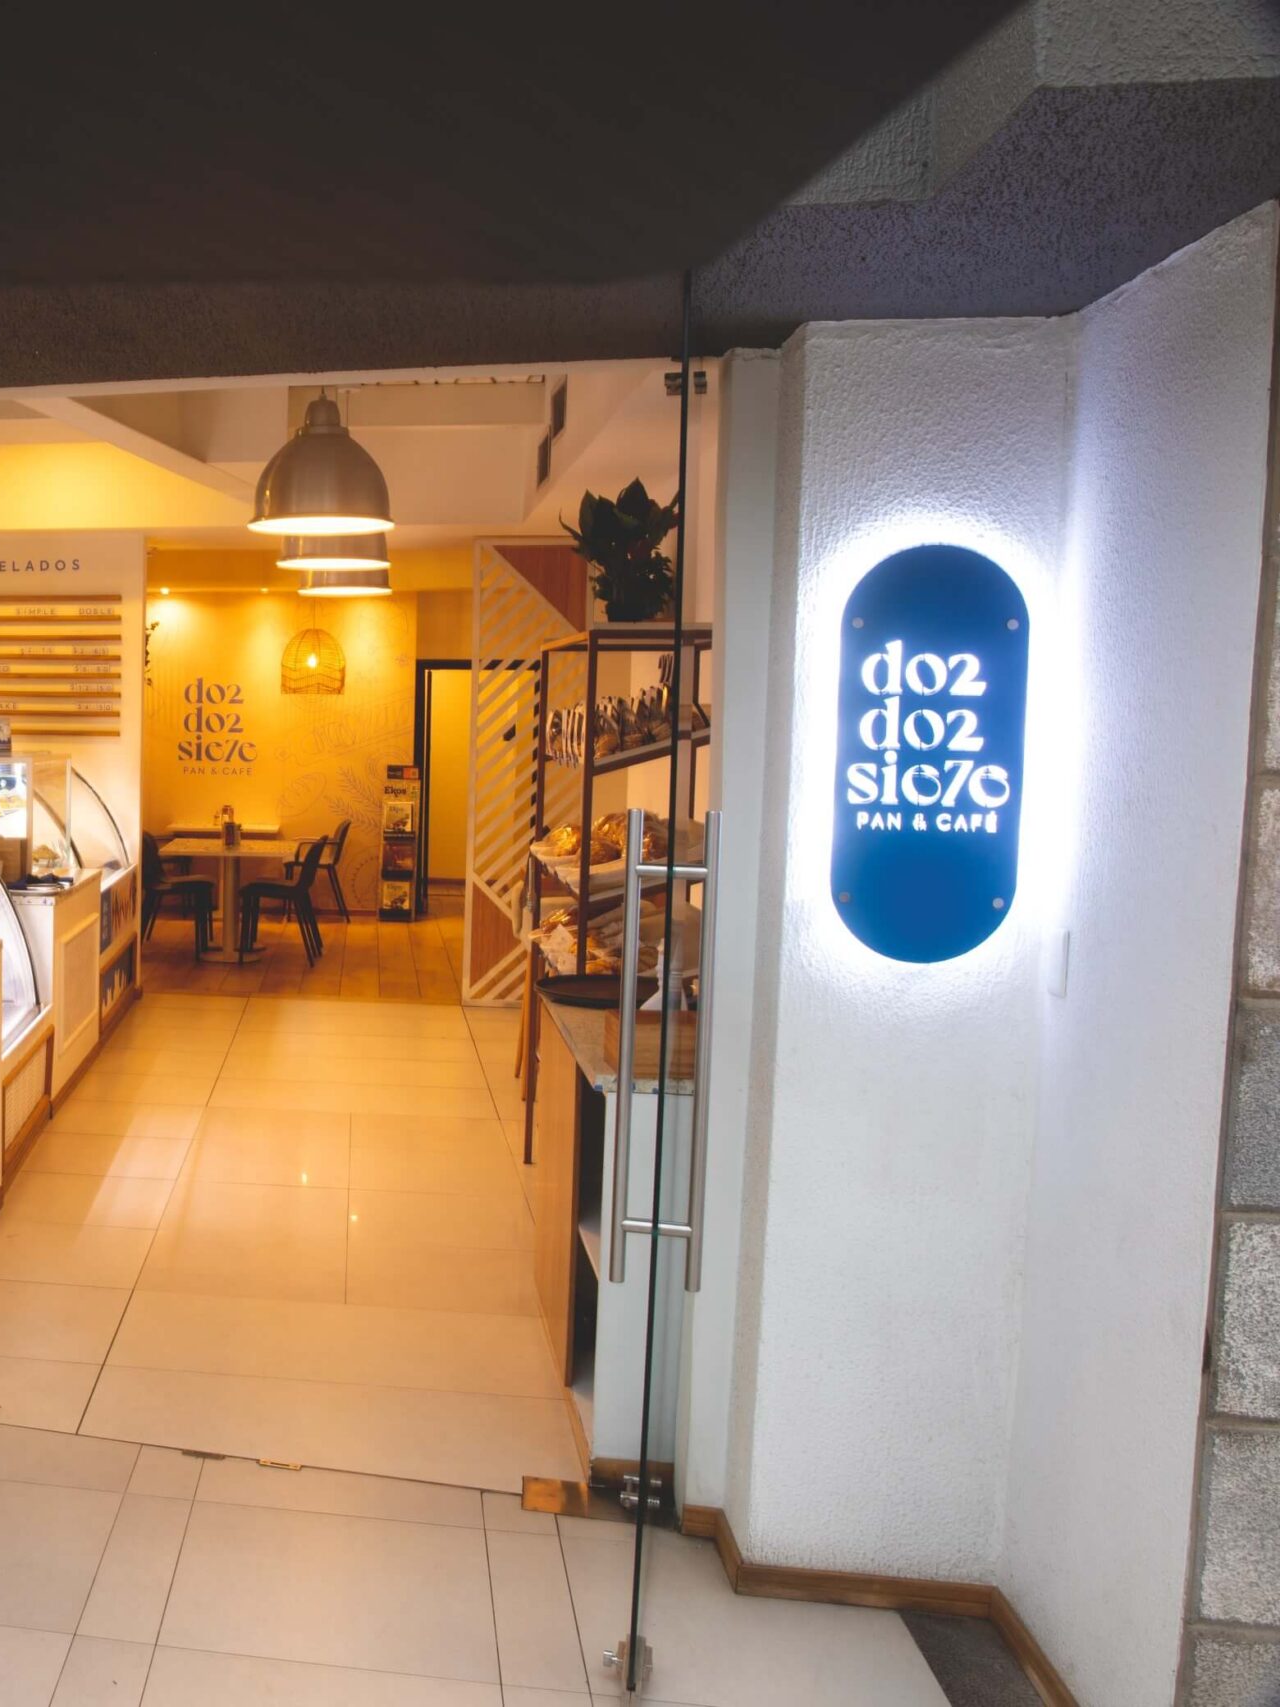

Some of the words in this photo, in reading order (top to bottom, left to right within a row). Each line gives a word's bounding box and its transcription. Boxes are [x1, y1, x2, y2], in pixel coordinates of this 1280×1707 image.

[861, 640, 987, 696] do2
[184, 677, 244, 704] do2
[183, 706, 244, 733] do2
[859, 696, 984, 751] do2
[183, 766, 205, 775] PAN
[211, 767, 217, 775] &
[856, 811, 902, 830] PAN
[912, 812, 927, 831] &
